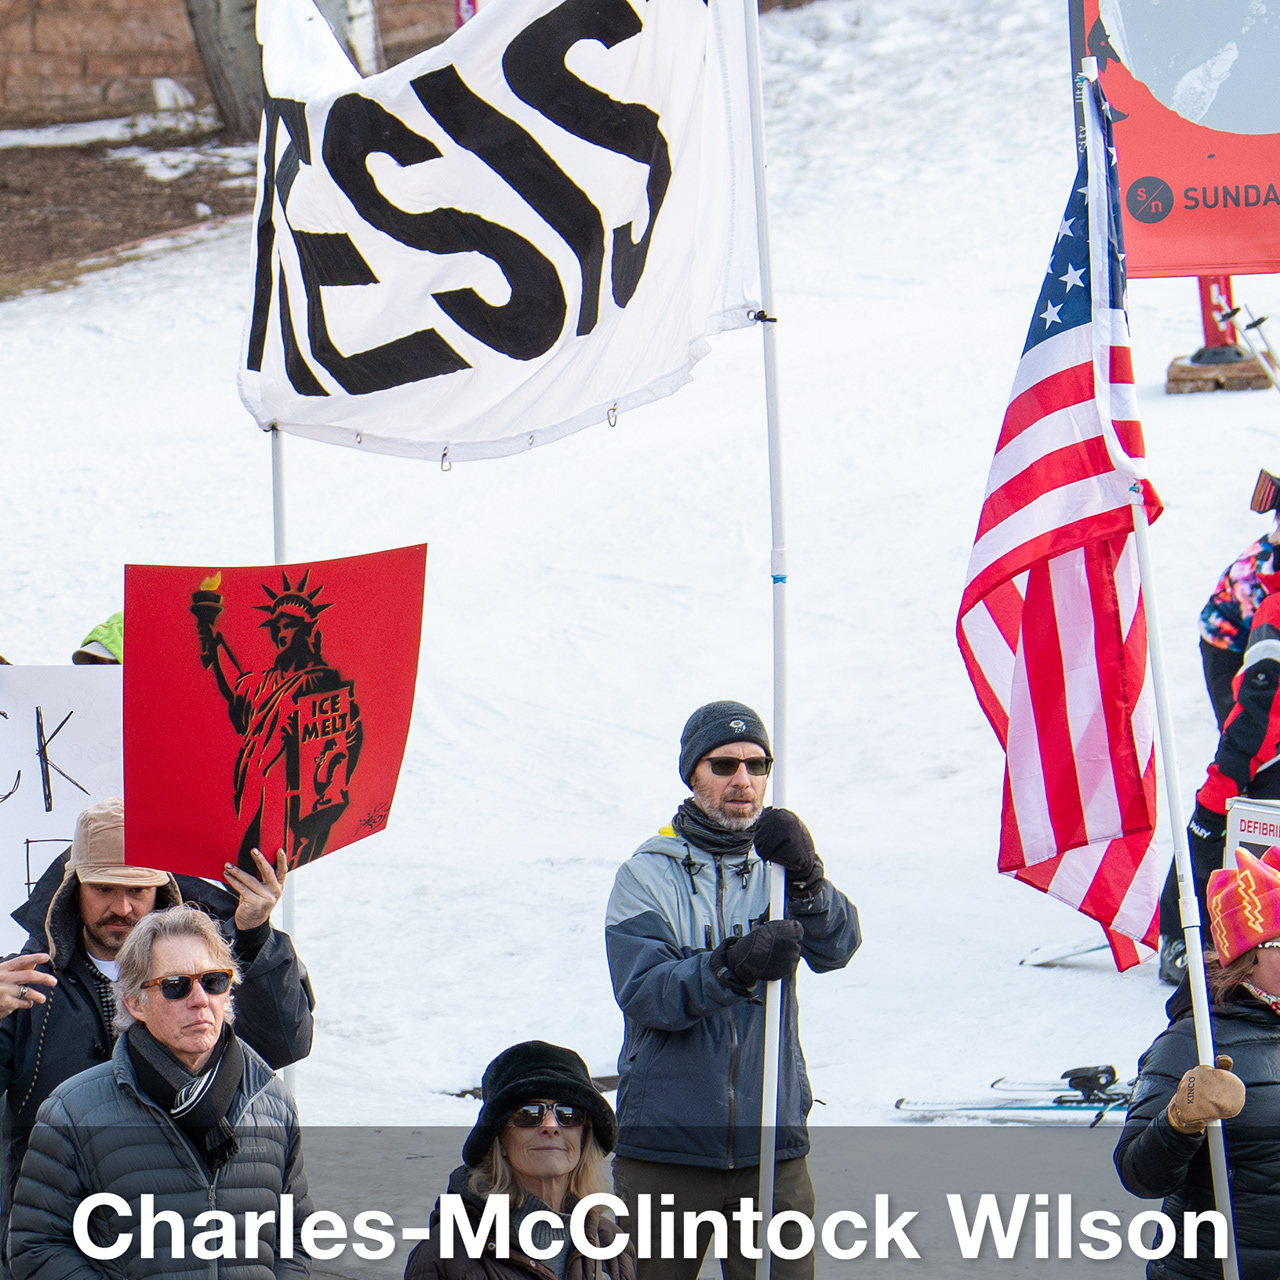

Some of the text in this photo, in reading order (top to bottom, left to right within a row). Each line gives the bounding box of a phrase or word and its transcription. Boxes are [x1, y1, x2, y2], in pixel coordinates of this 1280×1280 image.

[247, 0, 674, 397] RESIS
[311, 694, 341, 718] ICE
[301, 712, 348, 743] MELT
